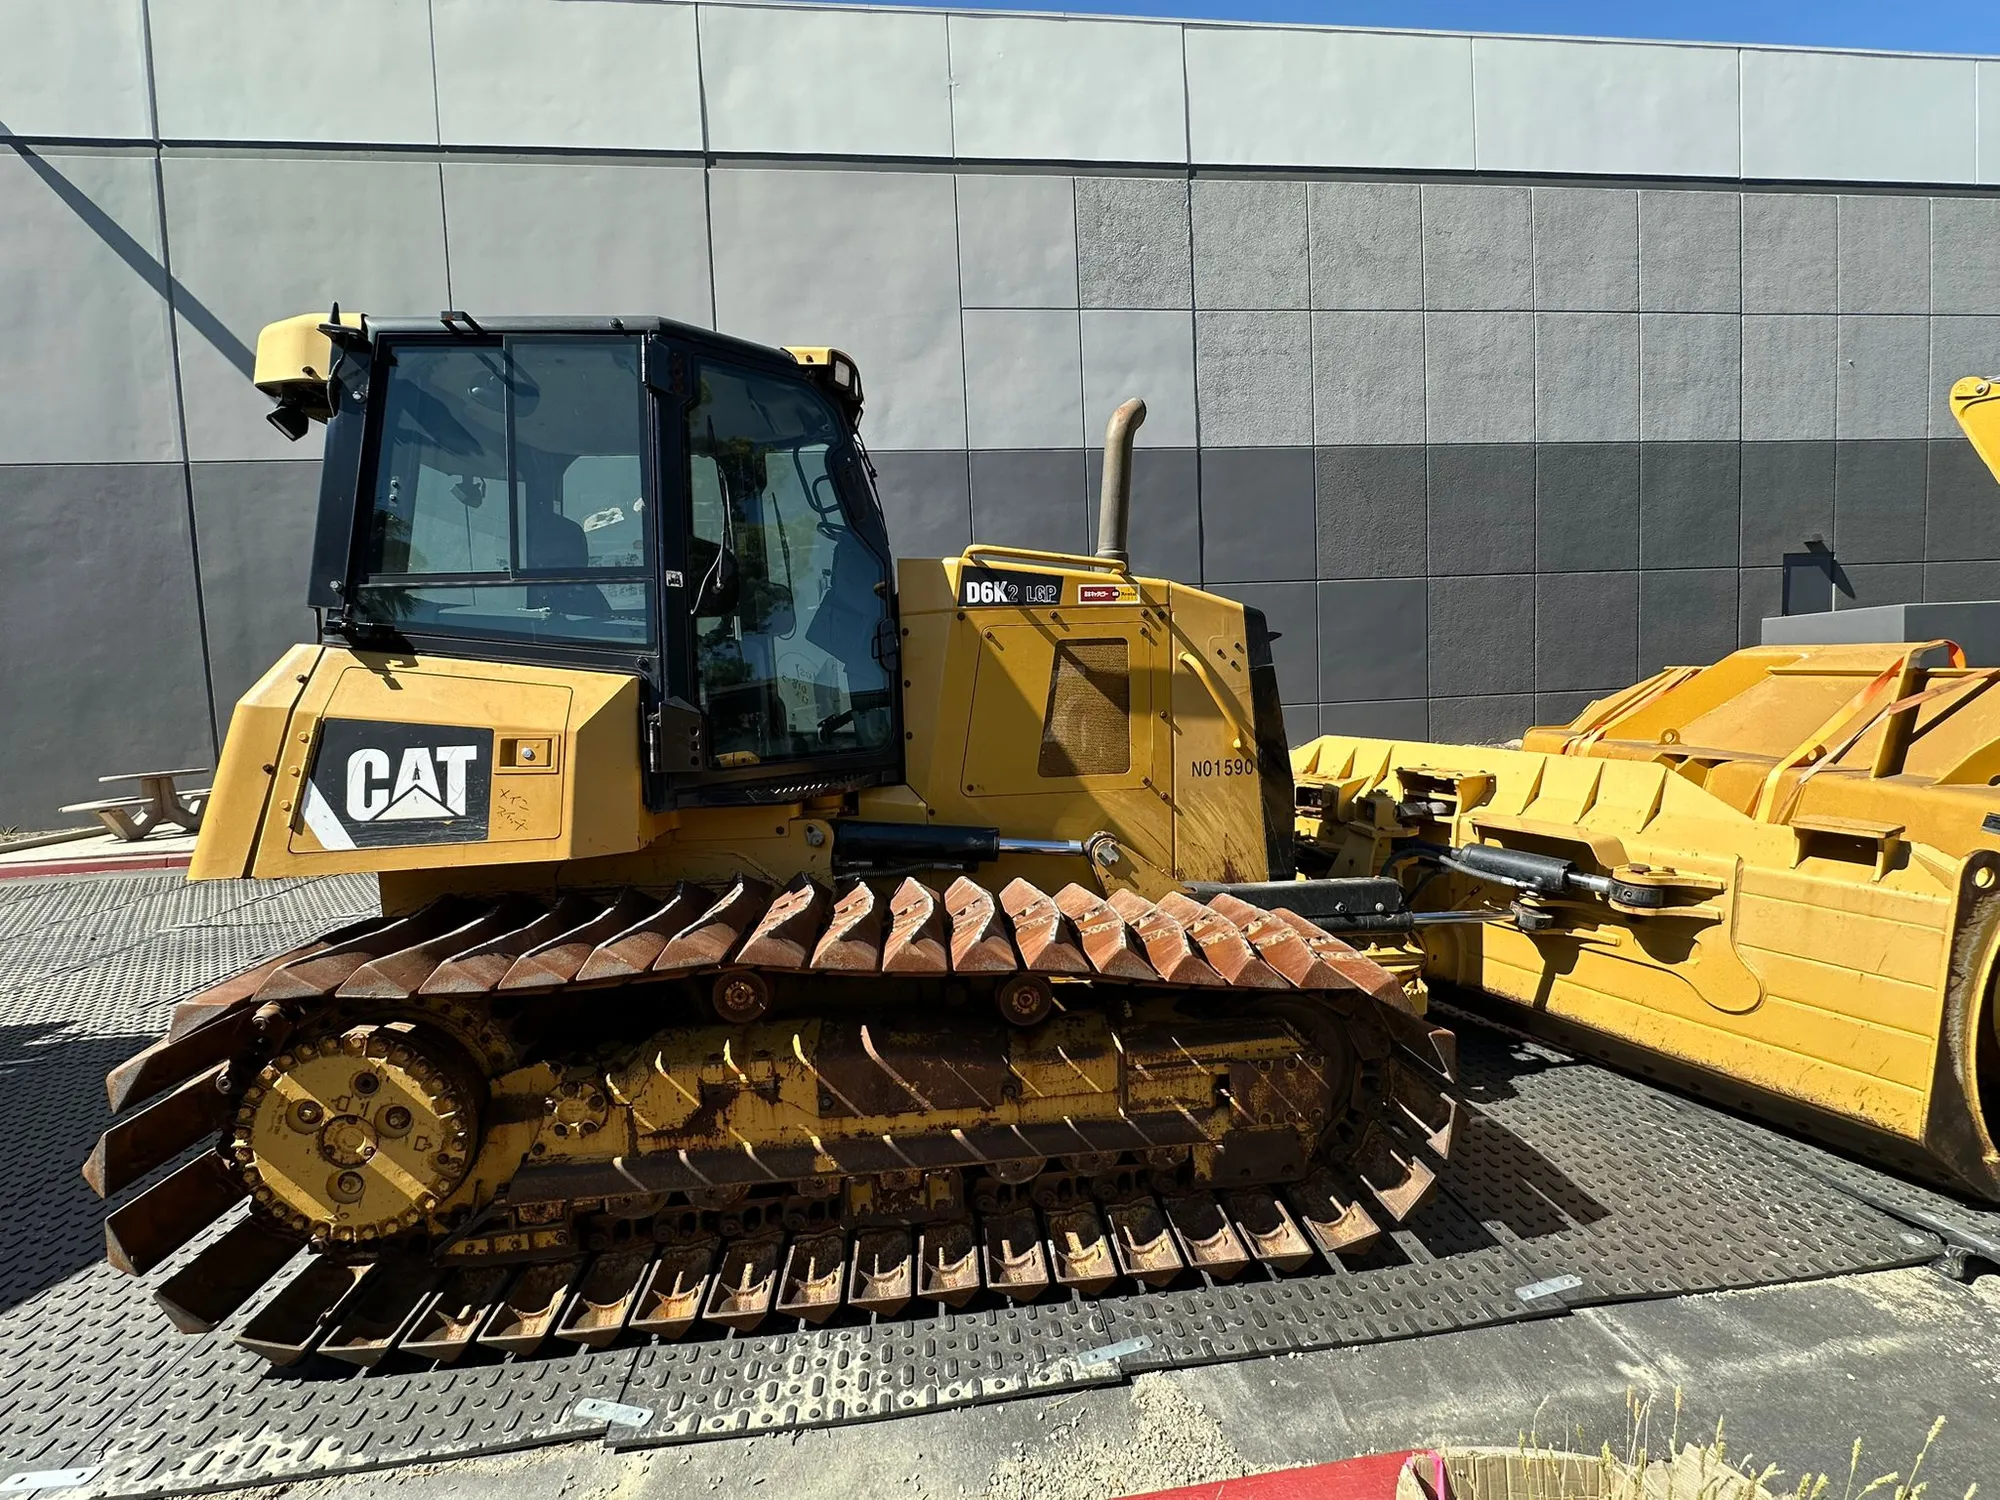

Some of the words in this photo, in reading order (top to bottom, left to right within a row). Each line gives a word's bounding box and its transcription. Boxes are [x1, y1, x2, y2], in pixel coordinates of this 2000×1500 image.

[1026, 585, 1057, 603] LGP
[1191, 758, 1253, 777] N01590
[346, 745, 477, 821] CAT
